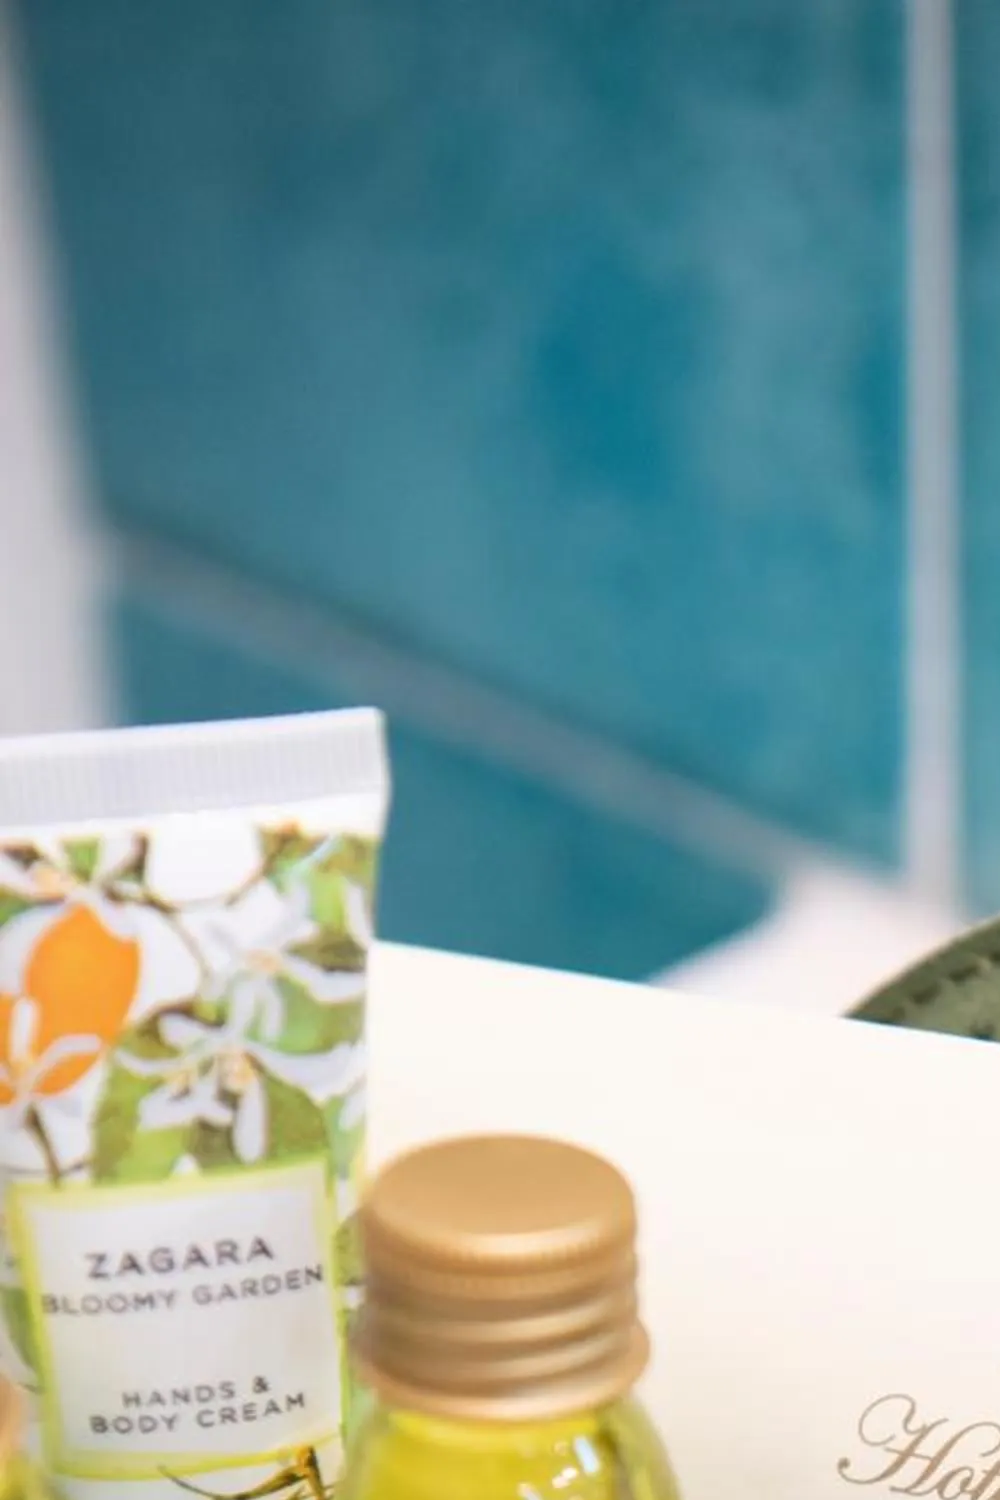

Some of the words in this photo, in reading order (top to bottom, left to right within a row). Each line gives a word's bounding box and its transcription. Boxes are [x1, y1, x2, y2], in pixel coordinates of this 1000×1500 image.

[84, 1236, 275, 1280] ZAGARA
[41, 1289, 179, 1316] BLOOMY
[191, 1264, 325, 1307] GARDEN
[121, 1380, 237, 1409] HANDS
[252, 1374, 272, 1395] &
[88, 1411, 181, 1435] BODY
[195, 1392, 306, 1430] CREAM
